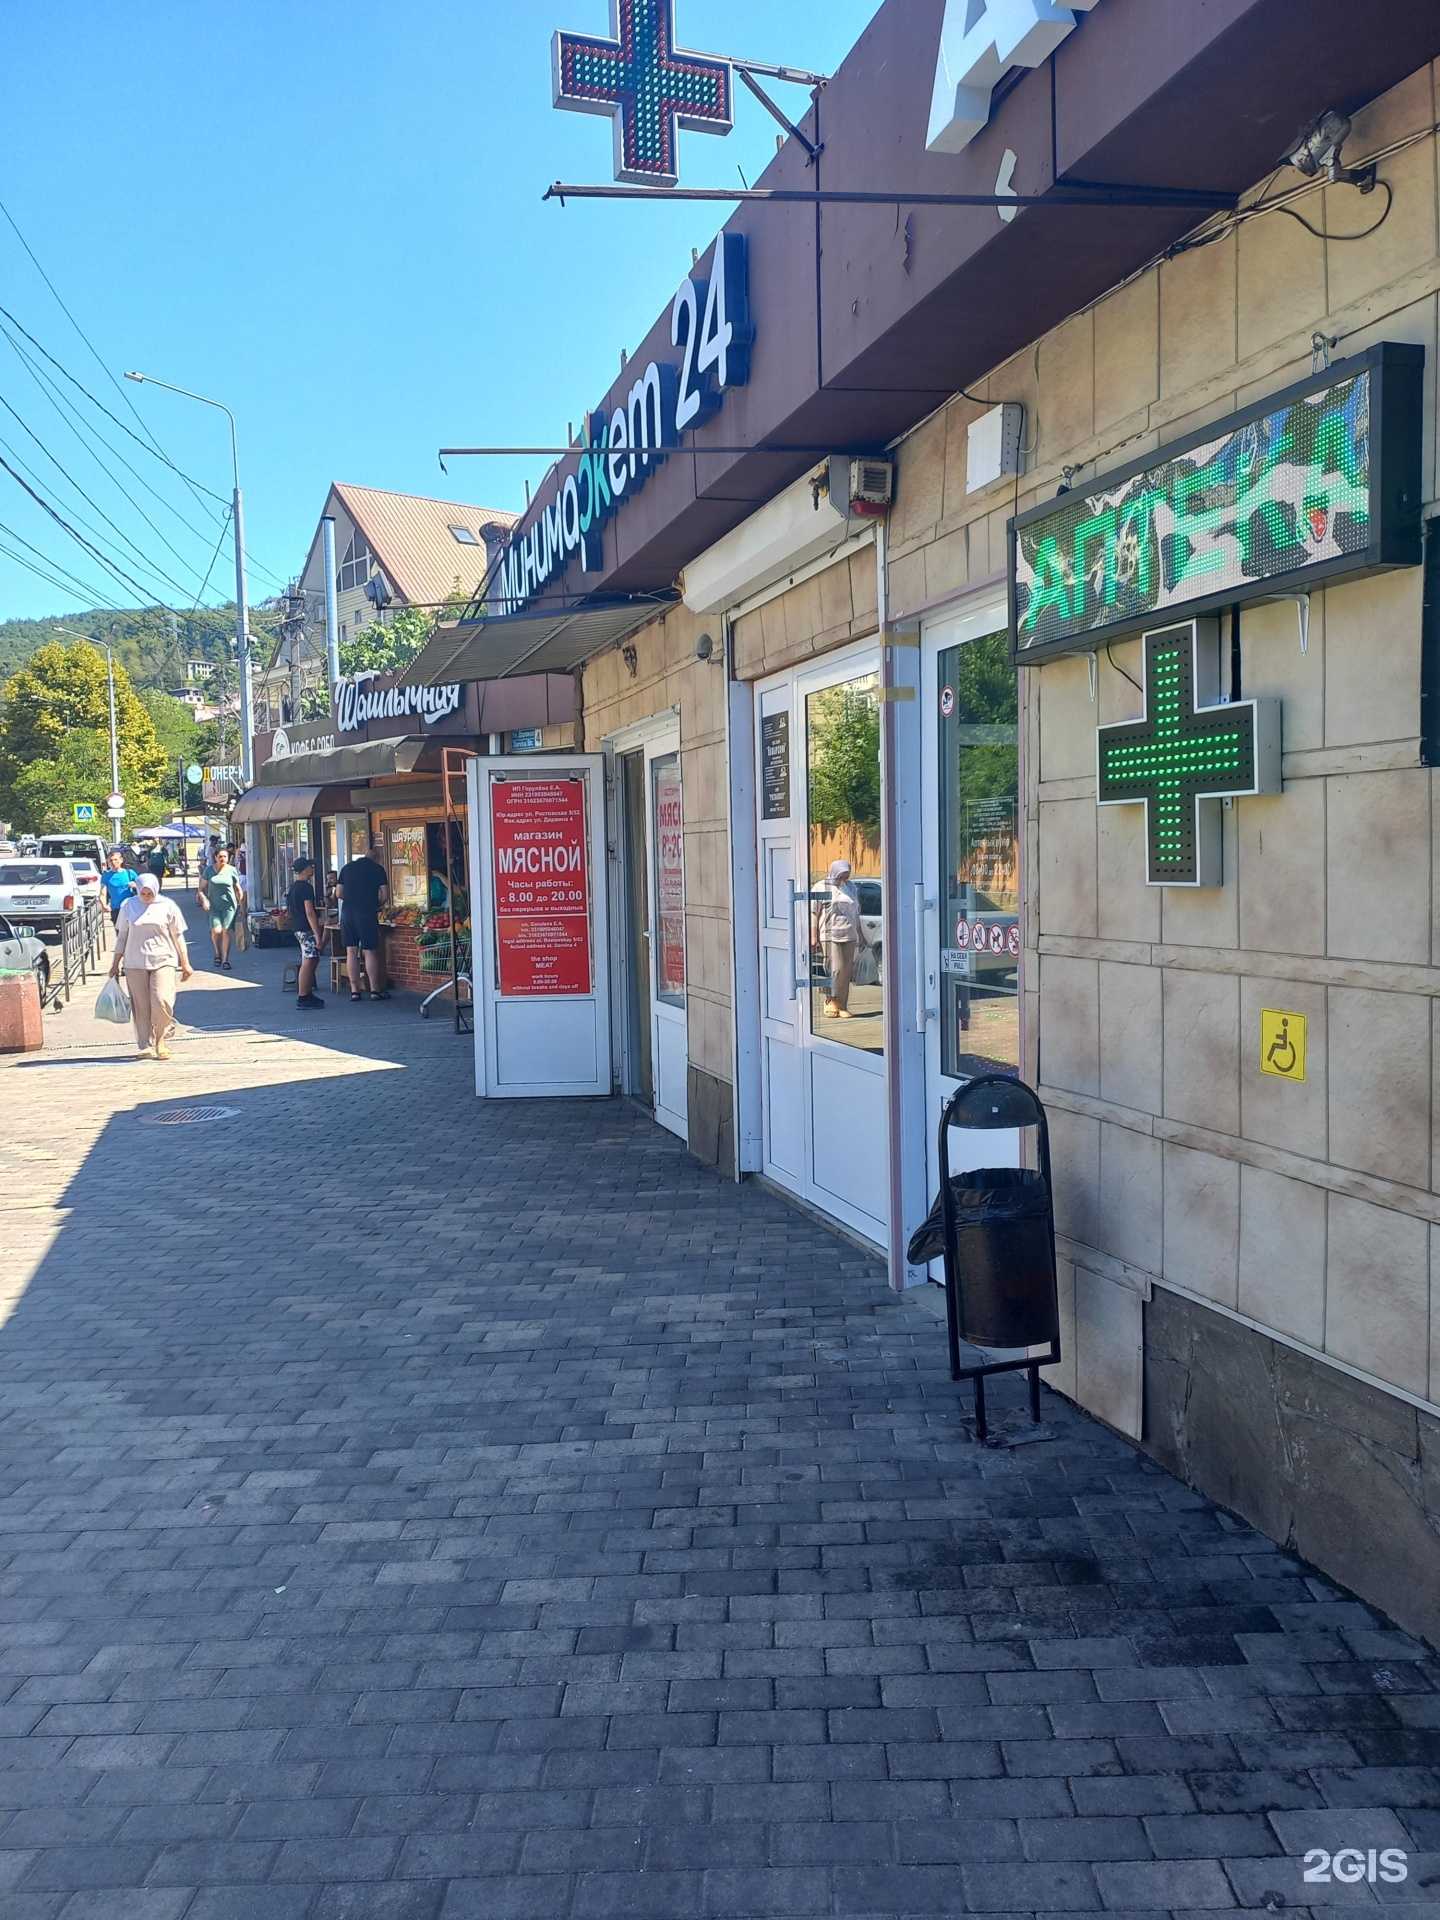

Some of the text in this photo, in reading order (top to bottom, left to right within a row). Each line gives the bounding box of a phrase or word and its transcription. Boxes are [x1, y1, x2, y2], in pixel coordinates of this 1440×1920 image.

[671, 230, 732, 430] 24
[1024, 413, 1369, 632] АПТЕКА
[335, 670, 461, 731] Шашлычная
[291, 739, 309, 754] КОФЕ
[514, 831, 563, 841] магазин
[498, 839, 581, 874] МЯСНОЙ
[507, 879, 574, 889] Часы работы:
[508, 892, 533, 902] 8.00
[551, 890, 583, 901] 20.00
